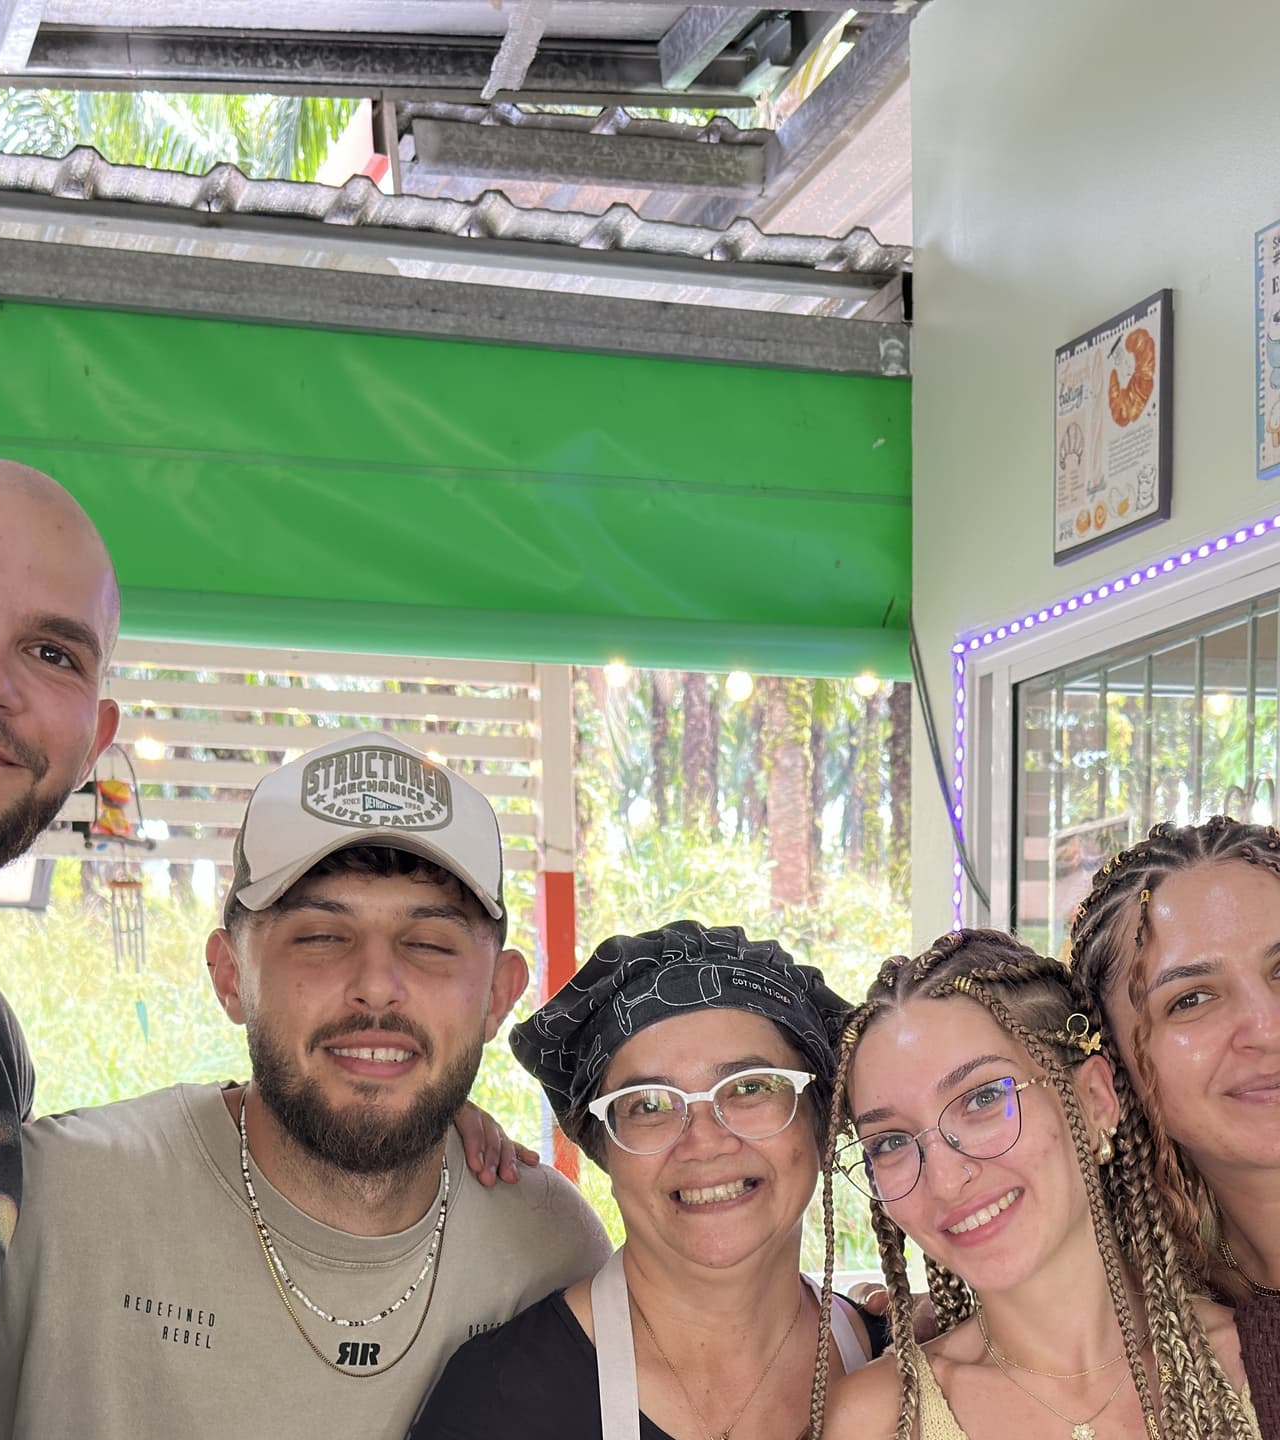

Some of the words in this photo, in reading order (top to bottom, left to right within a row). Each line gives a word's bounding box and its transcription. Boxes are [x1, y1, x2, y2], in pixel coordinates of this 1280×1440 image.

[307, 751, 451, 808] STRUCTURED
[333, 780, 425, 806] MECHANICS
[323, 803, 372, 824] AUTO
[379, 809, 436, 826] PARTS
[123, 1293, 216, 1328] REDEFINED
[162, 1326, 213, 1349] REBEL
